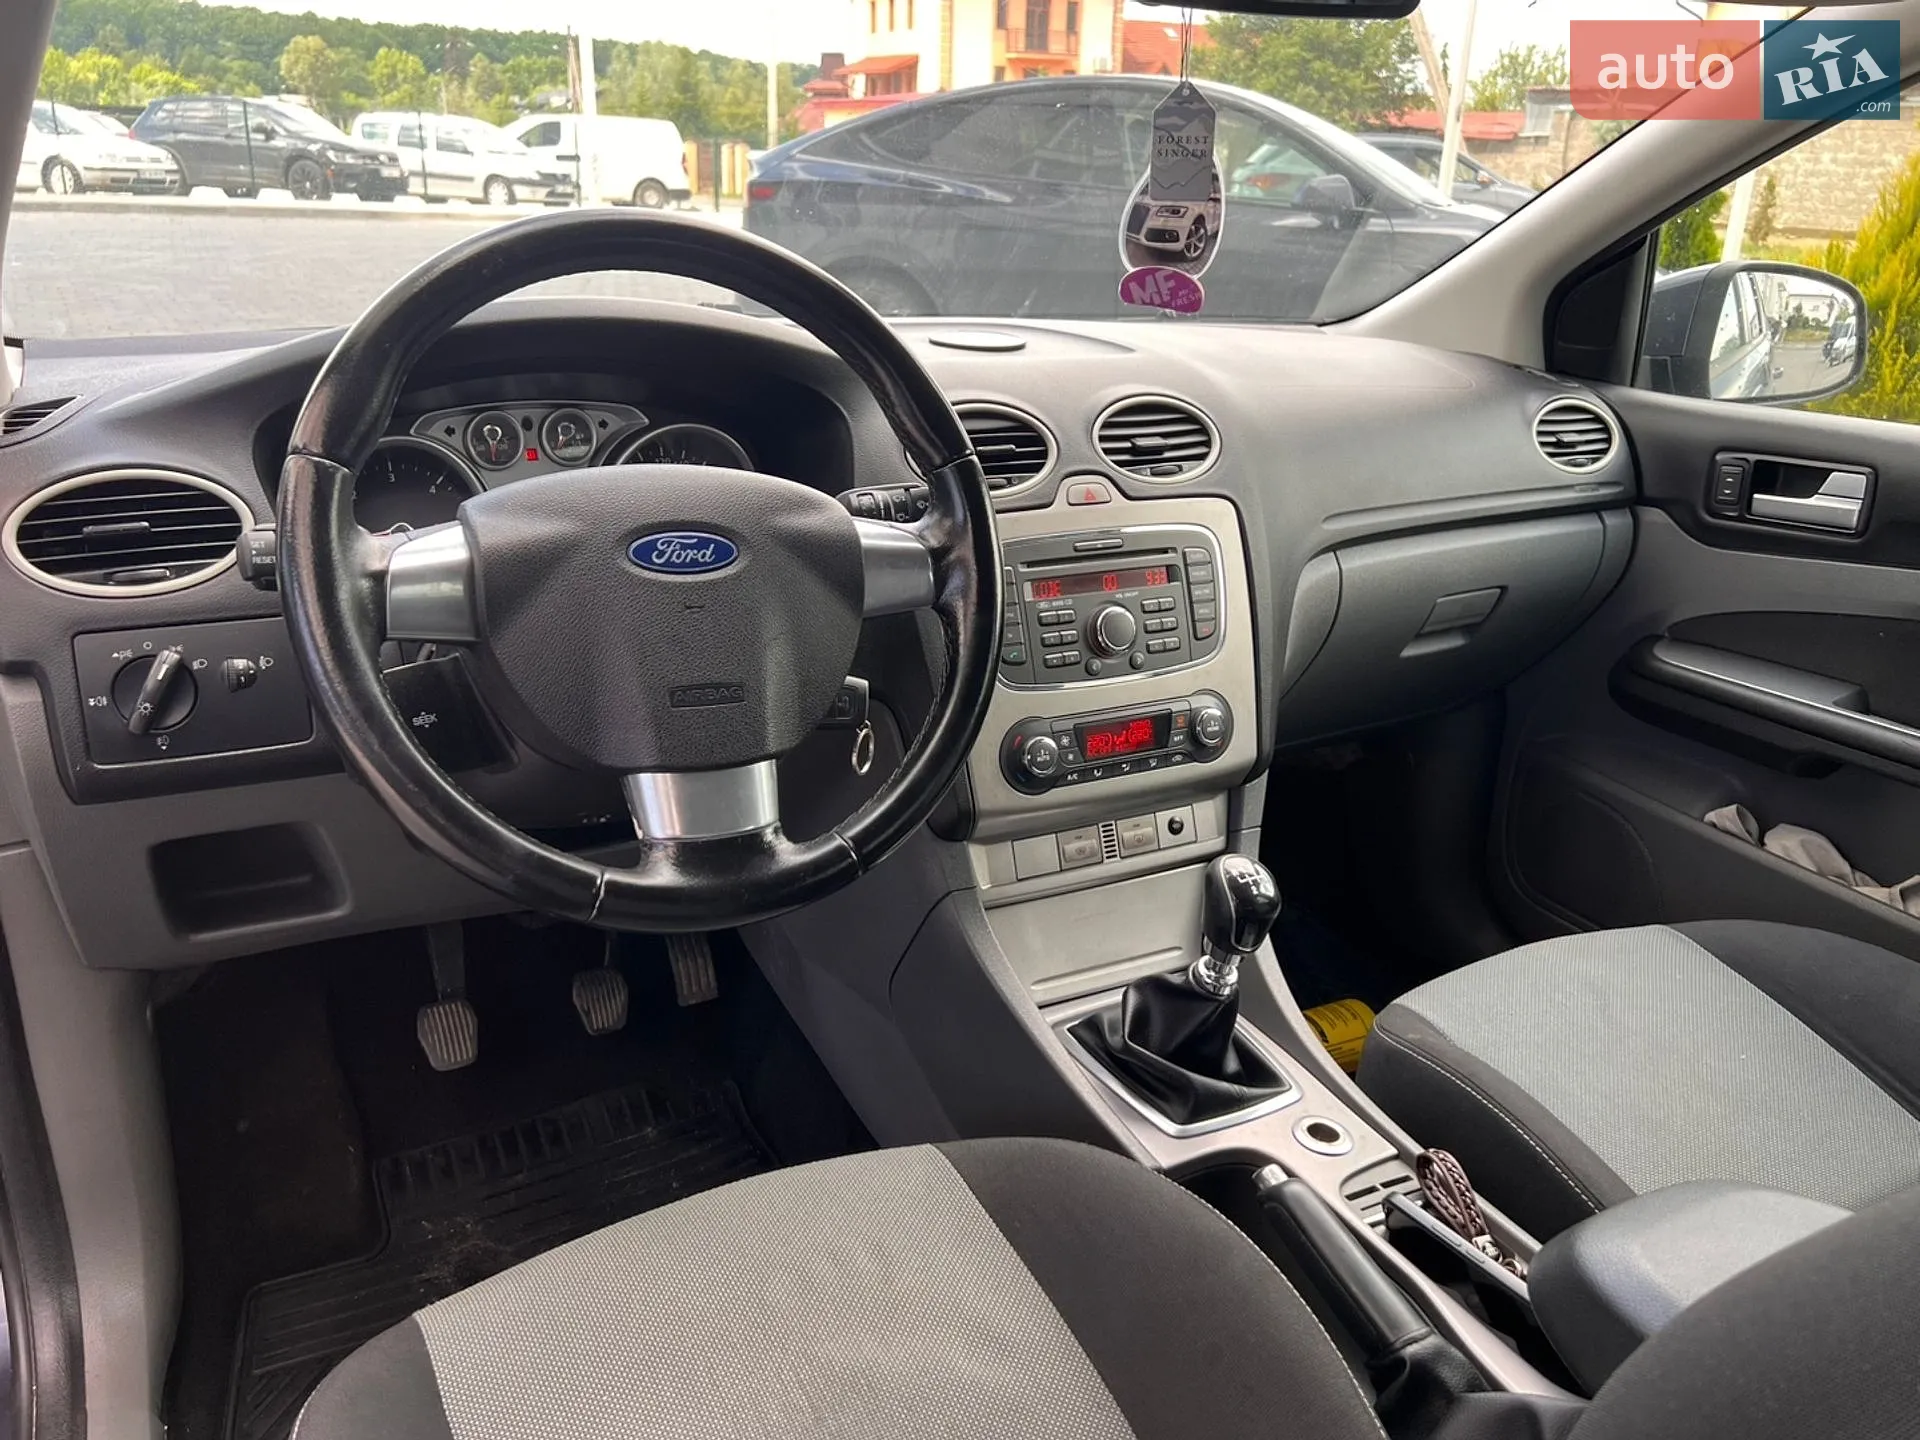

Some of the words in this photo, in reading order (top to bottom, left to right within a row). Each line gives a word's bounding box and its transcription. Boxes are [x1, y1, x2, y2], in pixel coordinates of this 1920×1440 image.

[1158, 135, 1209, 145] FOREST
[1157, 148, 1208, 158] SINGER
[1128, 270, 1176, 305] MF
[429, 485, 436, 494] 4
[651, 537, 716, 564] Ford
[673, 686, 743, 704] AIRBAG
[412, 713, 438, 726] SEEK
